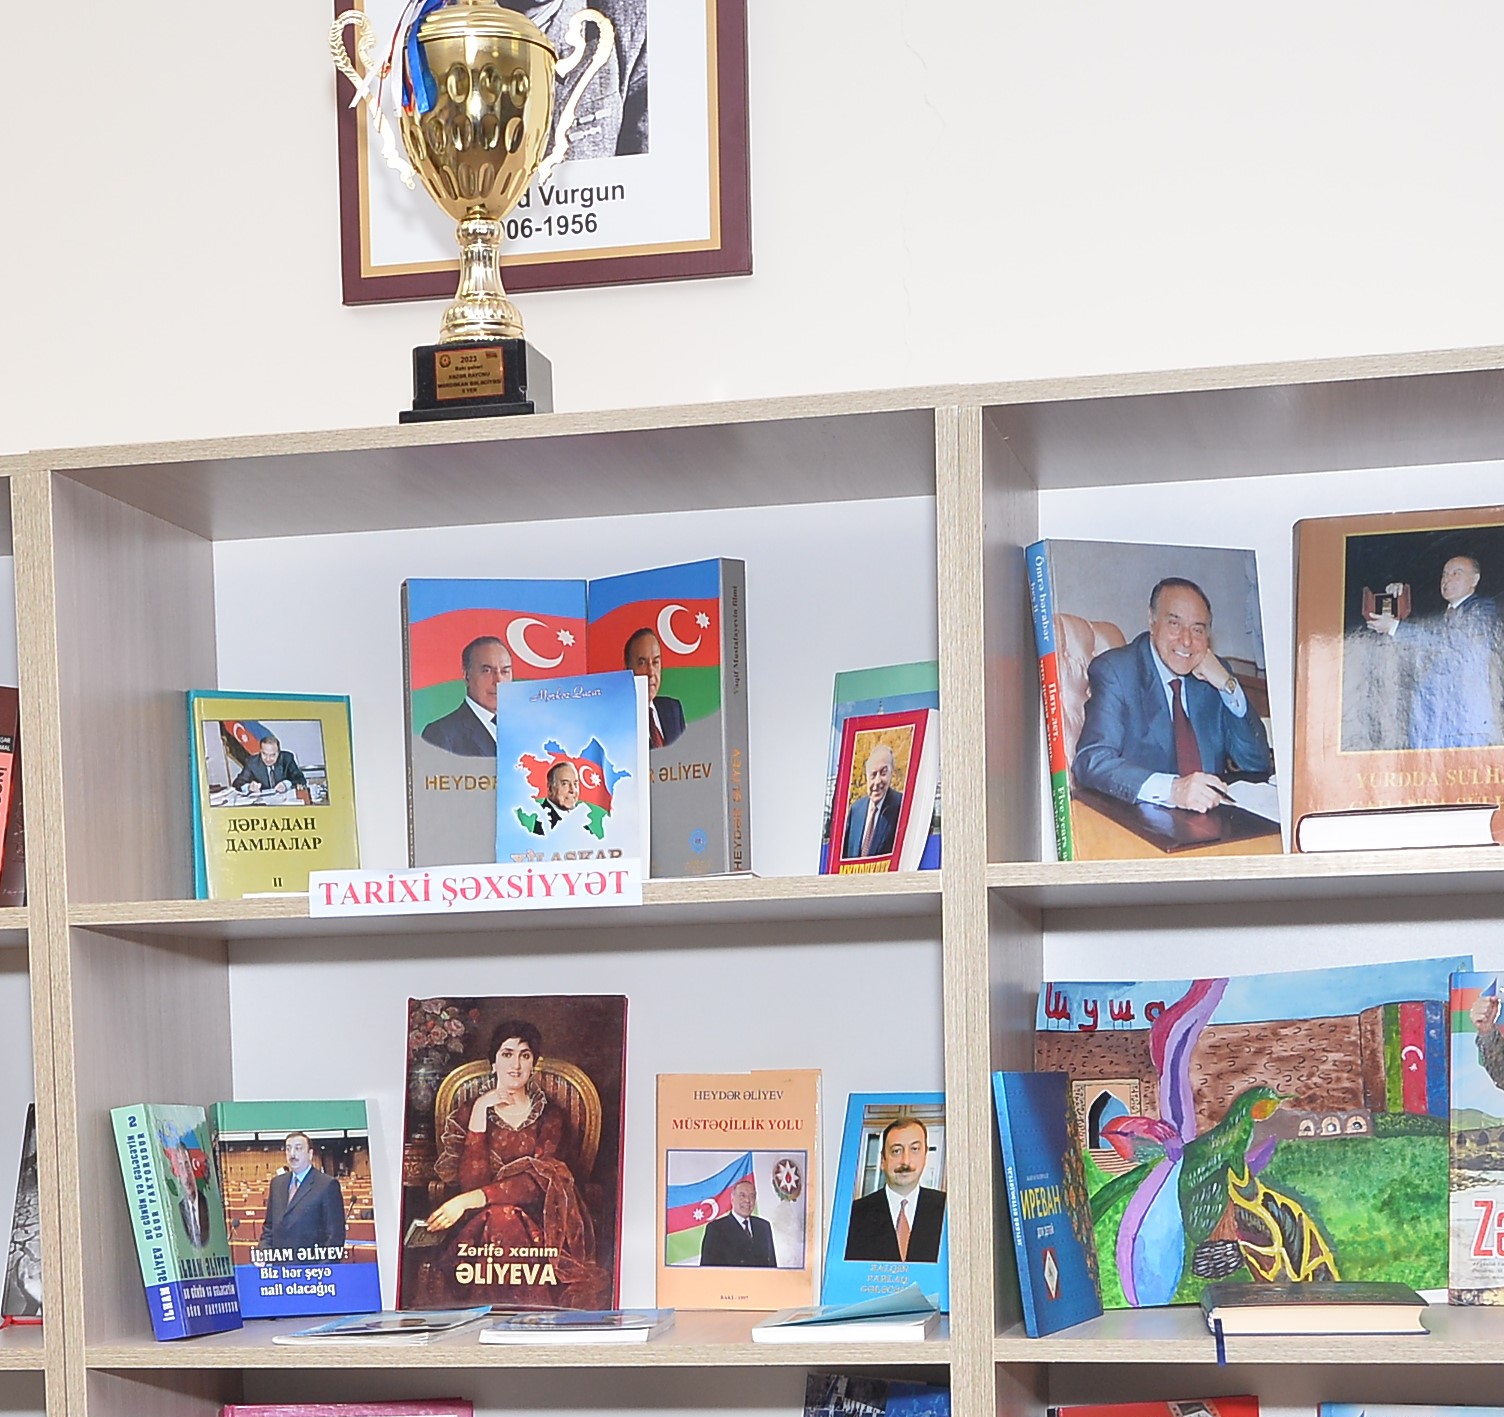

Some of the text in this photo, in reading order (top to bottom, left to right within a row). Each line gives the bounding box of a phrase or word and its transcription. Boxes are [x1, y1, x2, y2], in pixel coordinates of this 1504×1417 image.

[538, 184, 625, 208] Vurgun
[498, 213, 598, 240] 06-1956
[658, 762, 712, 782] ƏLİYEV
[225, 837, 322, 853] ДАМЛАЛАР
[318, 868, 629, 908] TARİXİ ŞƏXSİYYƏT
[693, 1089, 784, 1100] HEYDƏR ƏLİYEV
[672, 1116, 804, 1132] MÜSTƏQİLLİK YOLU
[1020, 1185, 1062, 1221] ИРЕВАН
[250, 1244, 349, 1263] İLHAM ƏLİYEV:
[457, 1243, 559, 1259] Zərifə xanım
[261, 1267, 332, 1281] Biz hər şeyə
[456, 1259, 558, 1286] ƏLİYEVA
[260, 1282, 336, 1297] nail olacağıq
[160, 1287, 175, 1322] İLHAM
